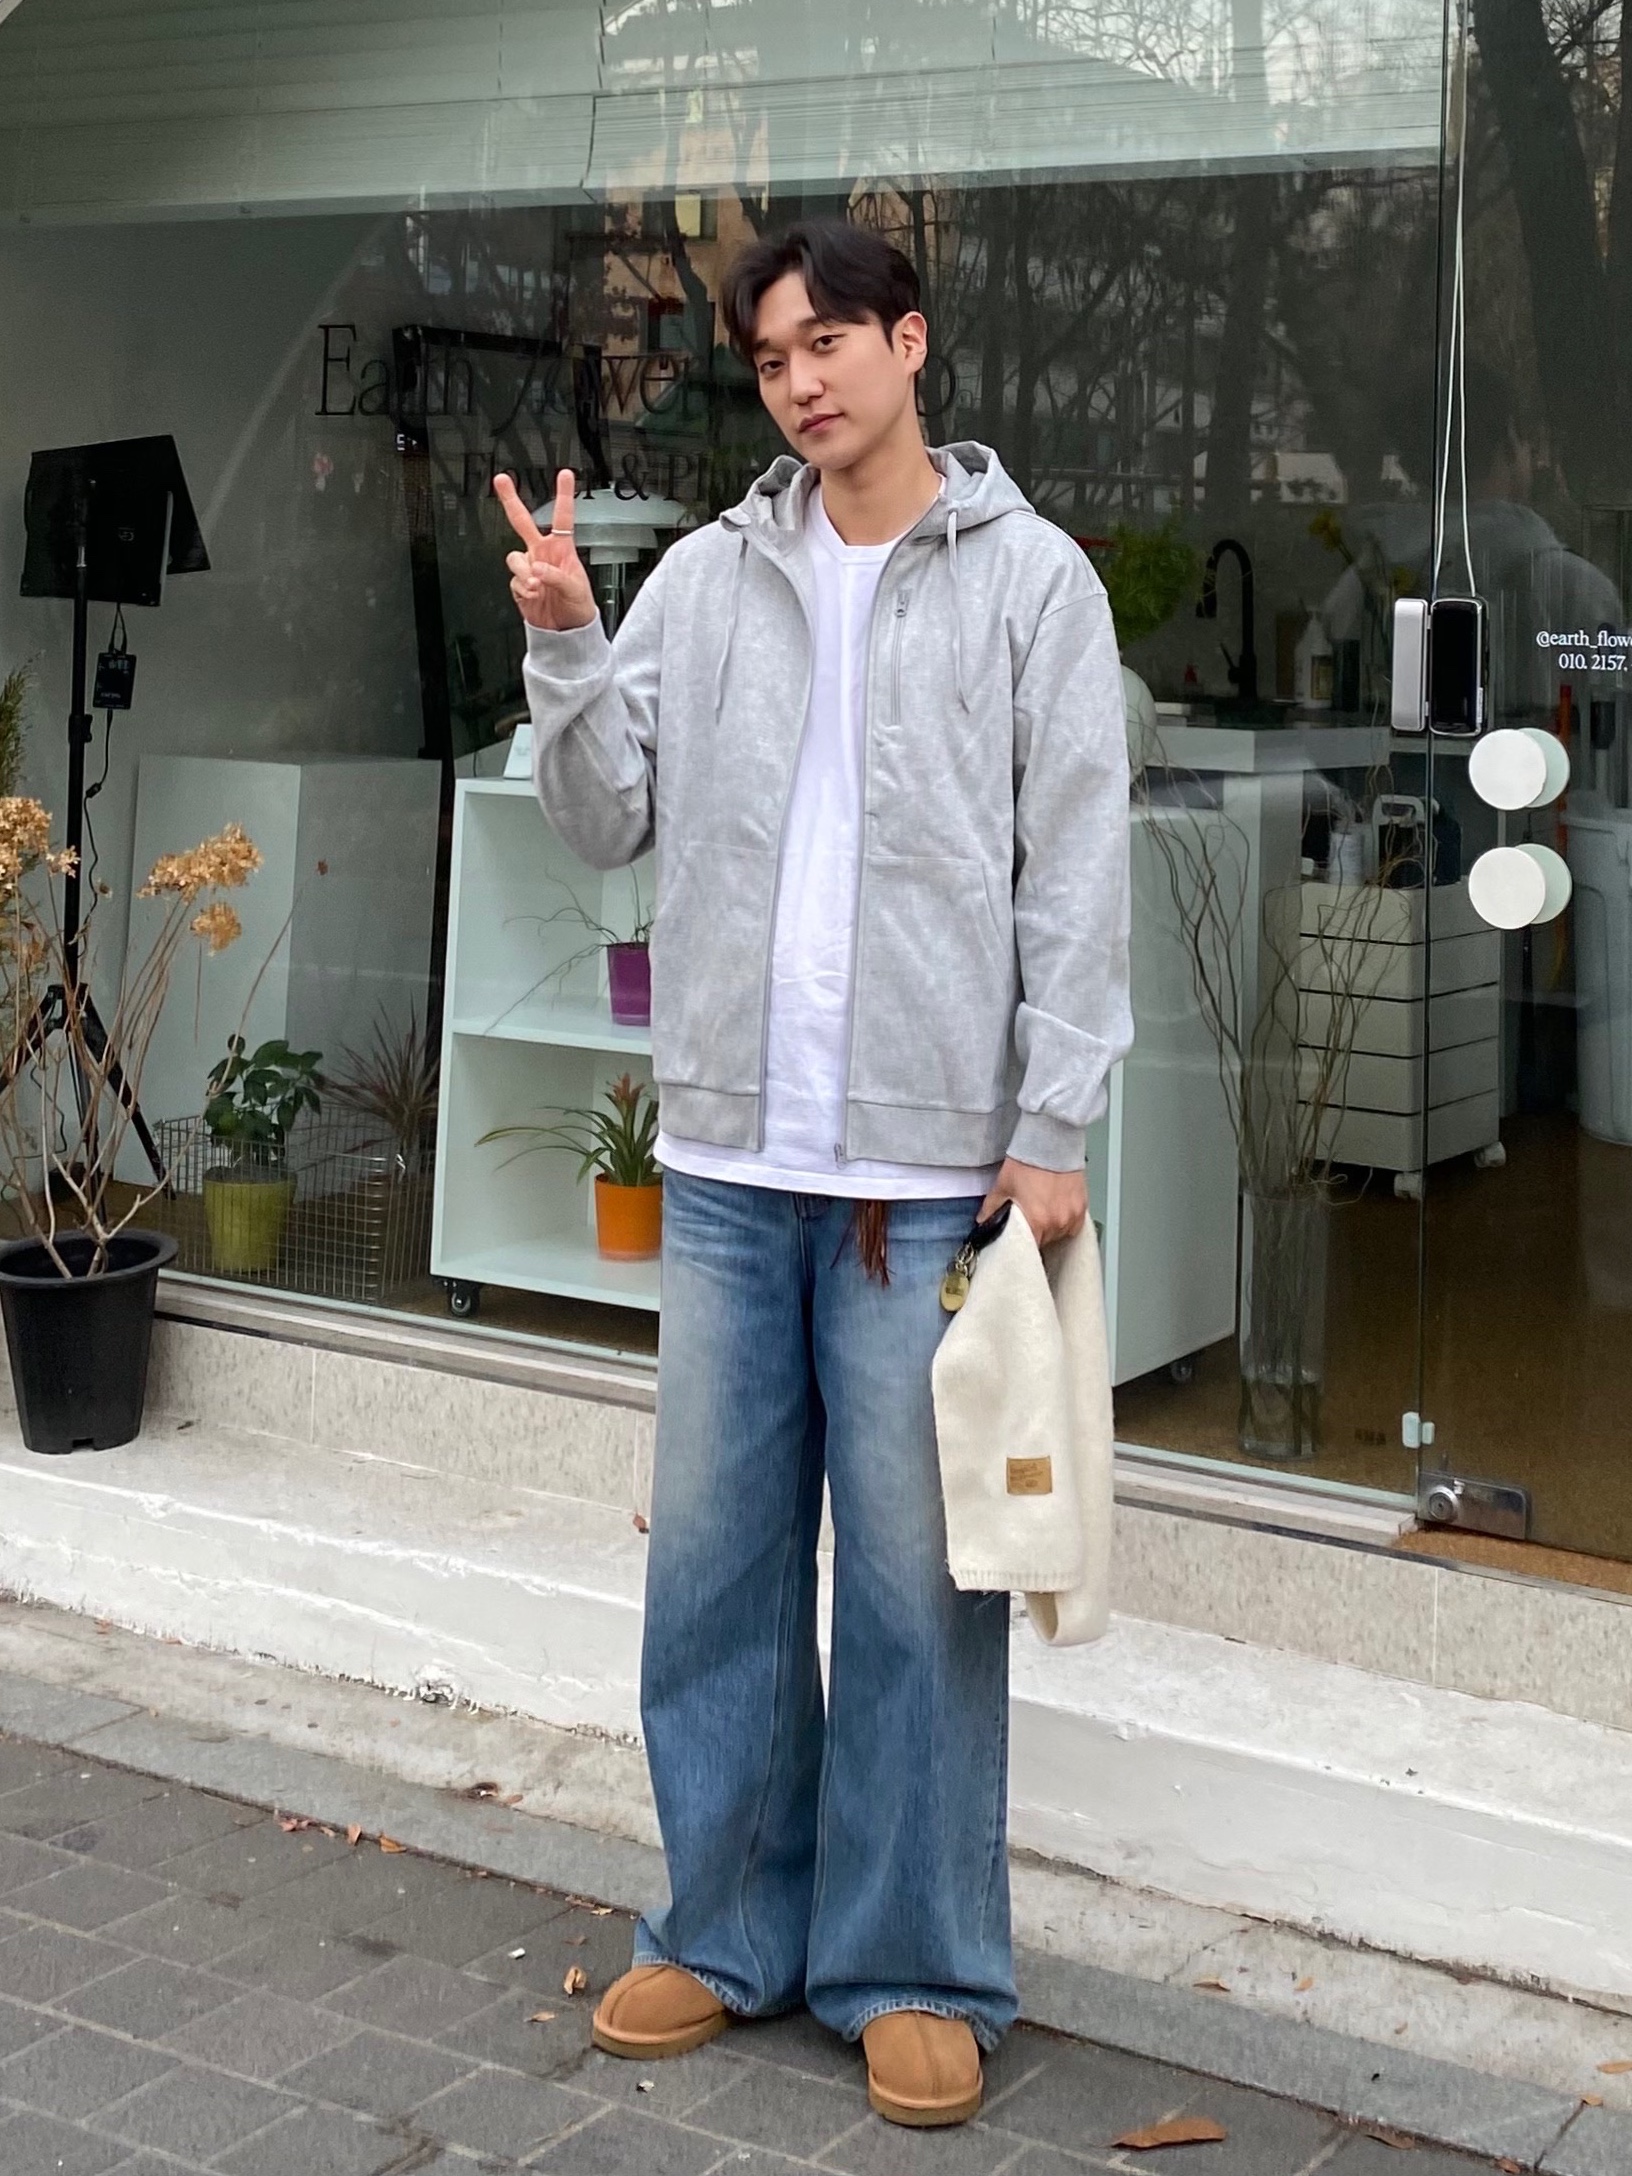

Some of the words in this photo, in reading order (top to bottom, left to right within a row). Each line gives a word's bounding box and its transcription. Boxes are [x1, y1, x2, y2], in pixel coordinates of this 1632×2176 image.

[462, 451, 598, 500] Flowr
[614, 453, 649, 501] &
[1535, 629, 1632, 649] @earth_flow
[1558, 652, 1588, 670] 010.
[1590, 654, 1629, 672] 2157.
